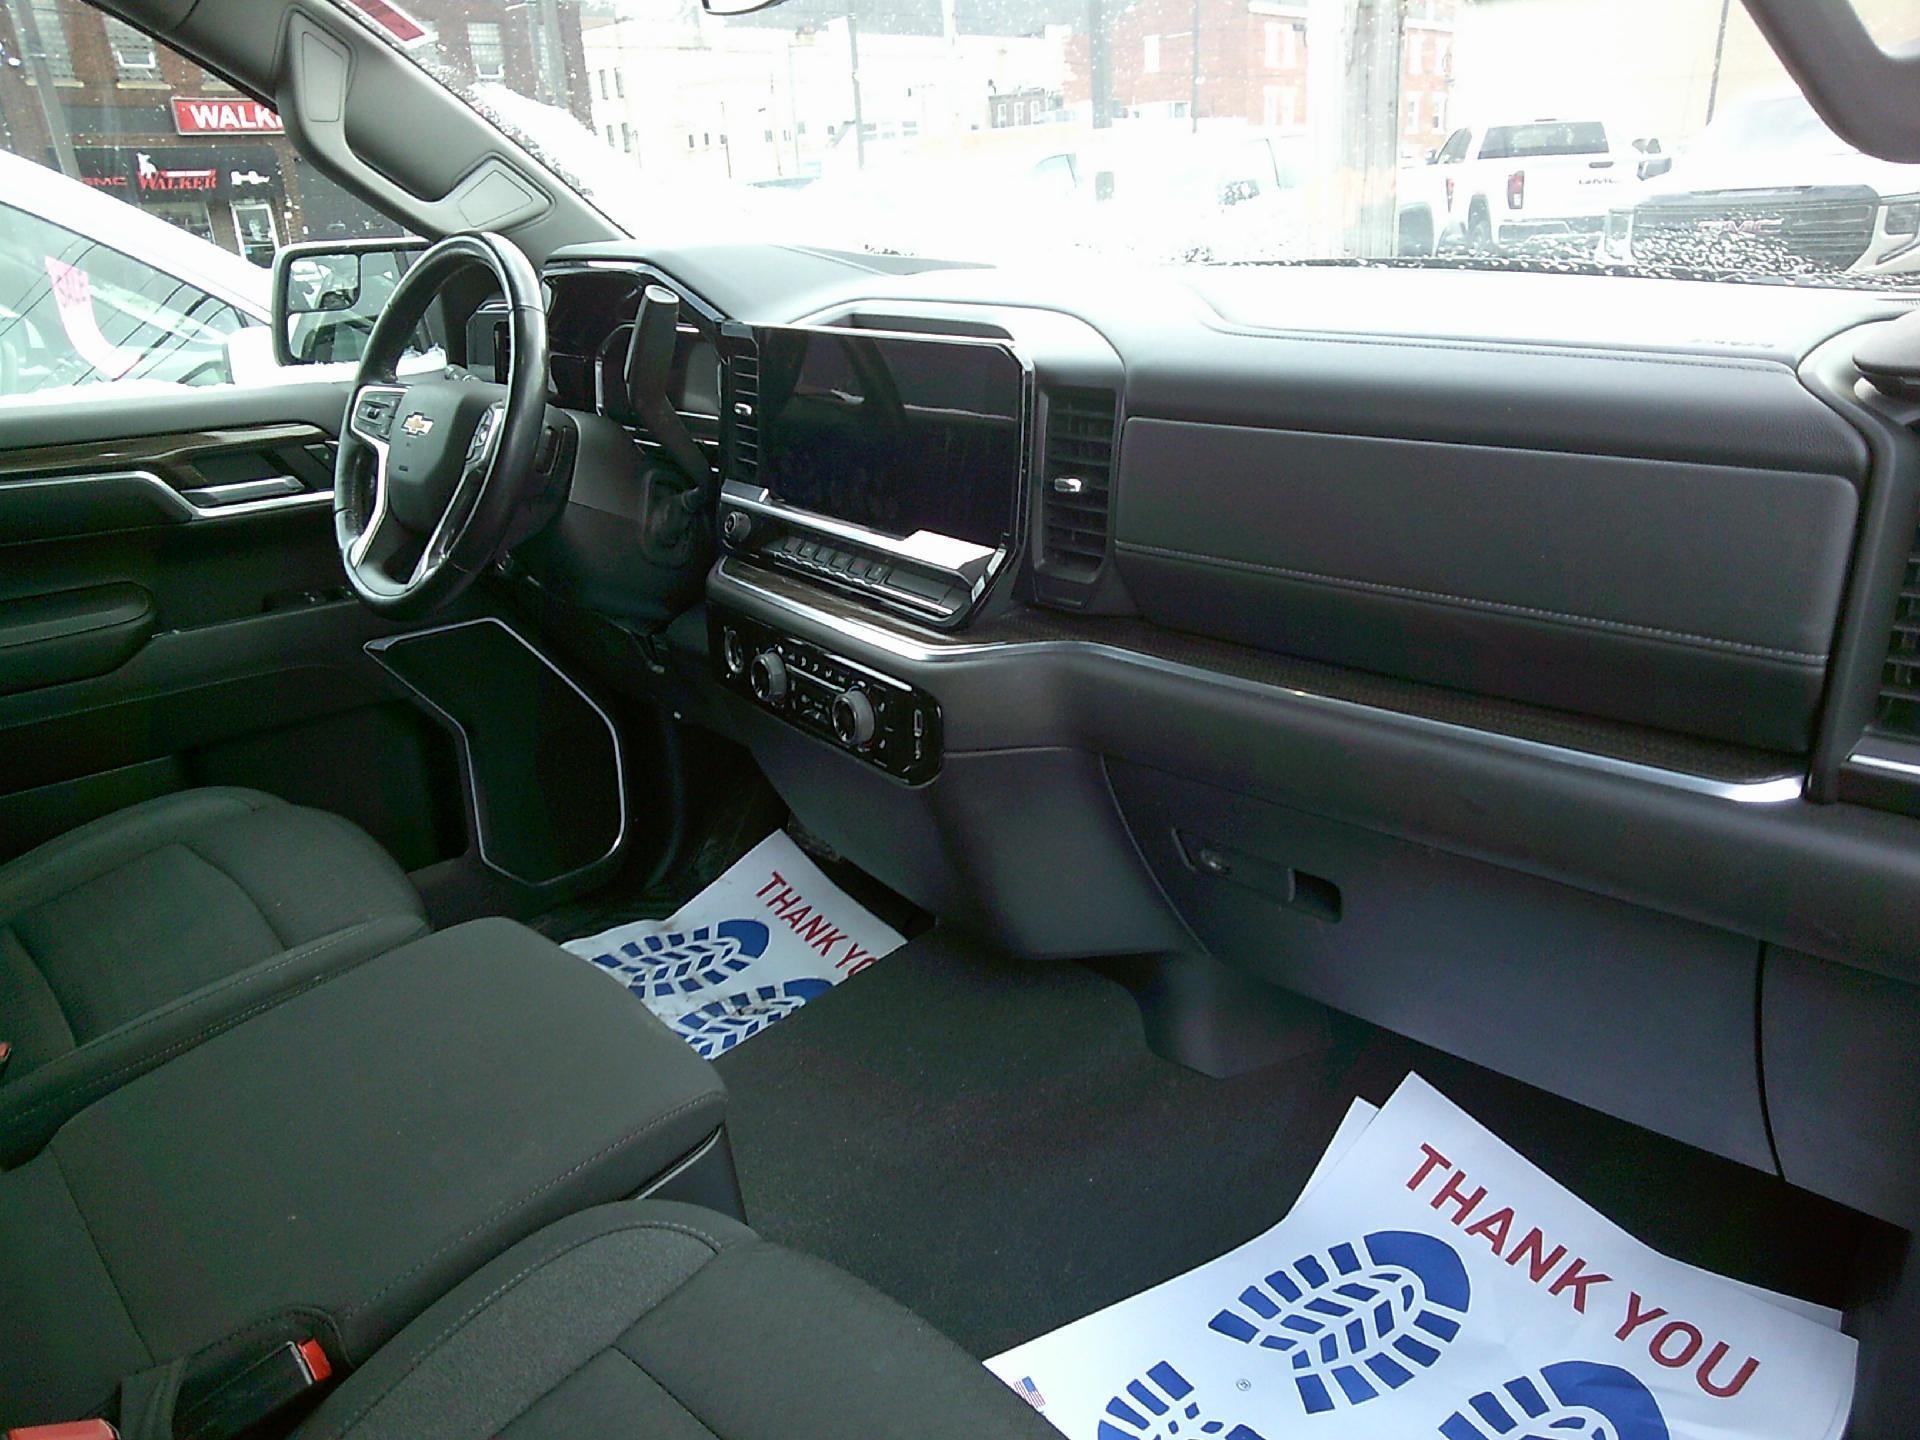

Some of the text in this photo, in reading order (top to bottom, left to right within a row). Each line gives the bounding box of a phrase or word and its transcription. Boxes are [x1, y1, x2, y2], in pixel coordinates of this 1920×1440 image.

[189, 105, 283, 128] WALK
[137, 170, 217, 191] WALKER
[756, 870, 848, 957] THANK
[1406, 1142, 1760, 1398] THANK YOU
